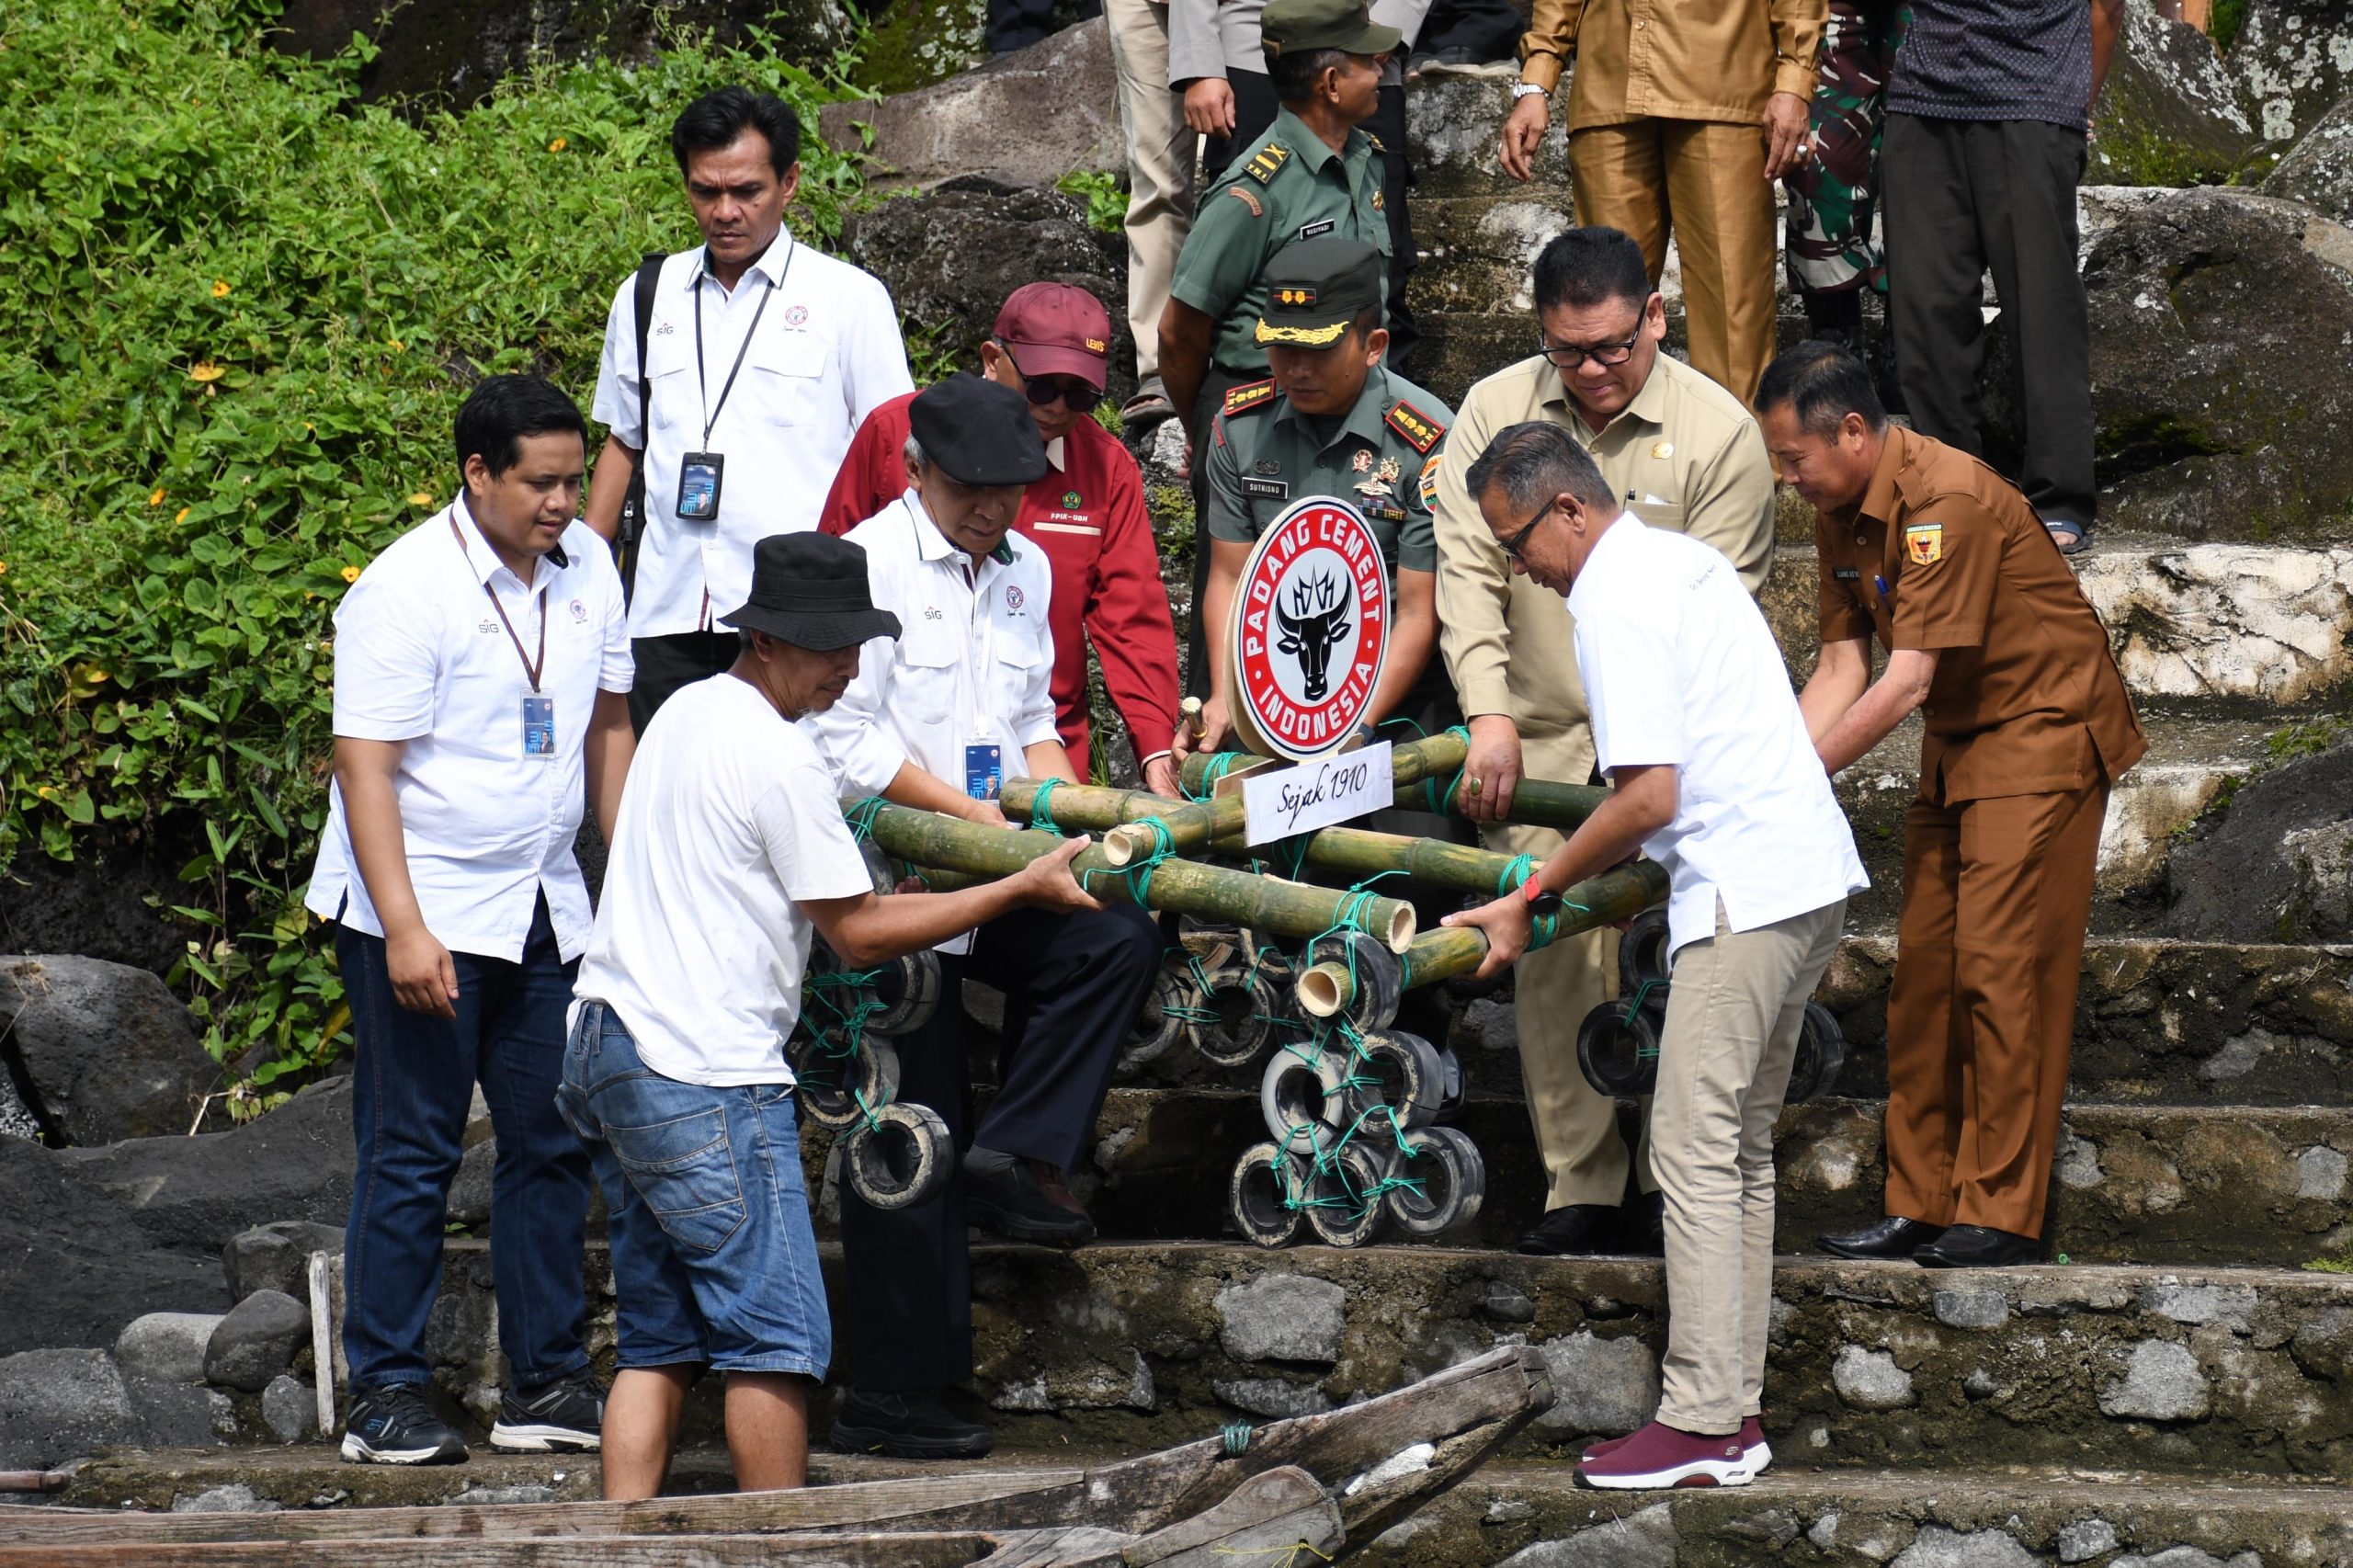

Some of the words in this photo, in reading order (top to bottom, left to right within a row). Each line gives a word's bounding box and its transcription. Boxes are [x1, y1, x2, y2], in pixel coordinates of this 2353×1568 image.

[1247, 164, 1267, 179] TNI
[656, 325, 674, 335] SIG
[1418, 426, 1439, 447] TNI
[1249, 483, 1279, 494] SUTRISNO
[1246, 517, 1310, 657] PADANG
[1320, 514, 1380, 621] CEMENT
[924, 610, 943, 620] SIG
[478, 623, 499, 634] SIG
[1258, 661, 1373, 741] INDONESIA
[1277, 763, 1330, 831] Sejak
[1330, 763, 1368, 801] 1910
